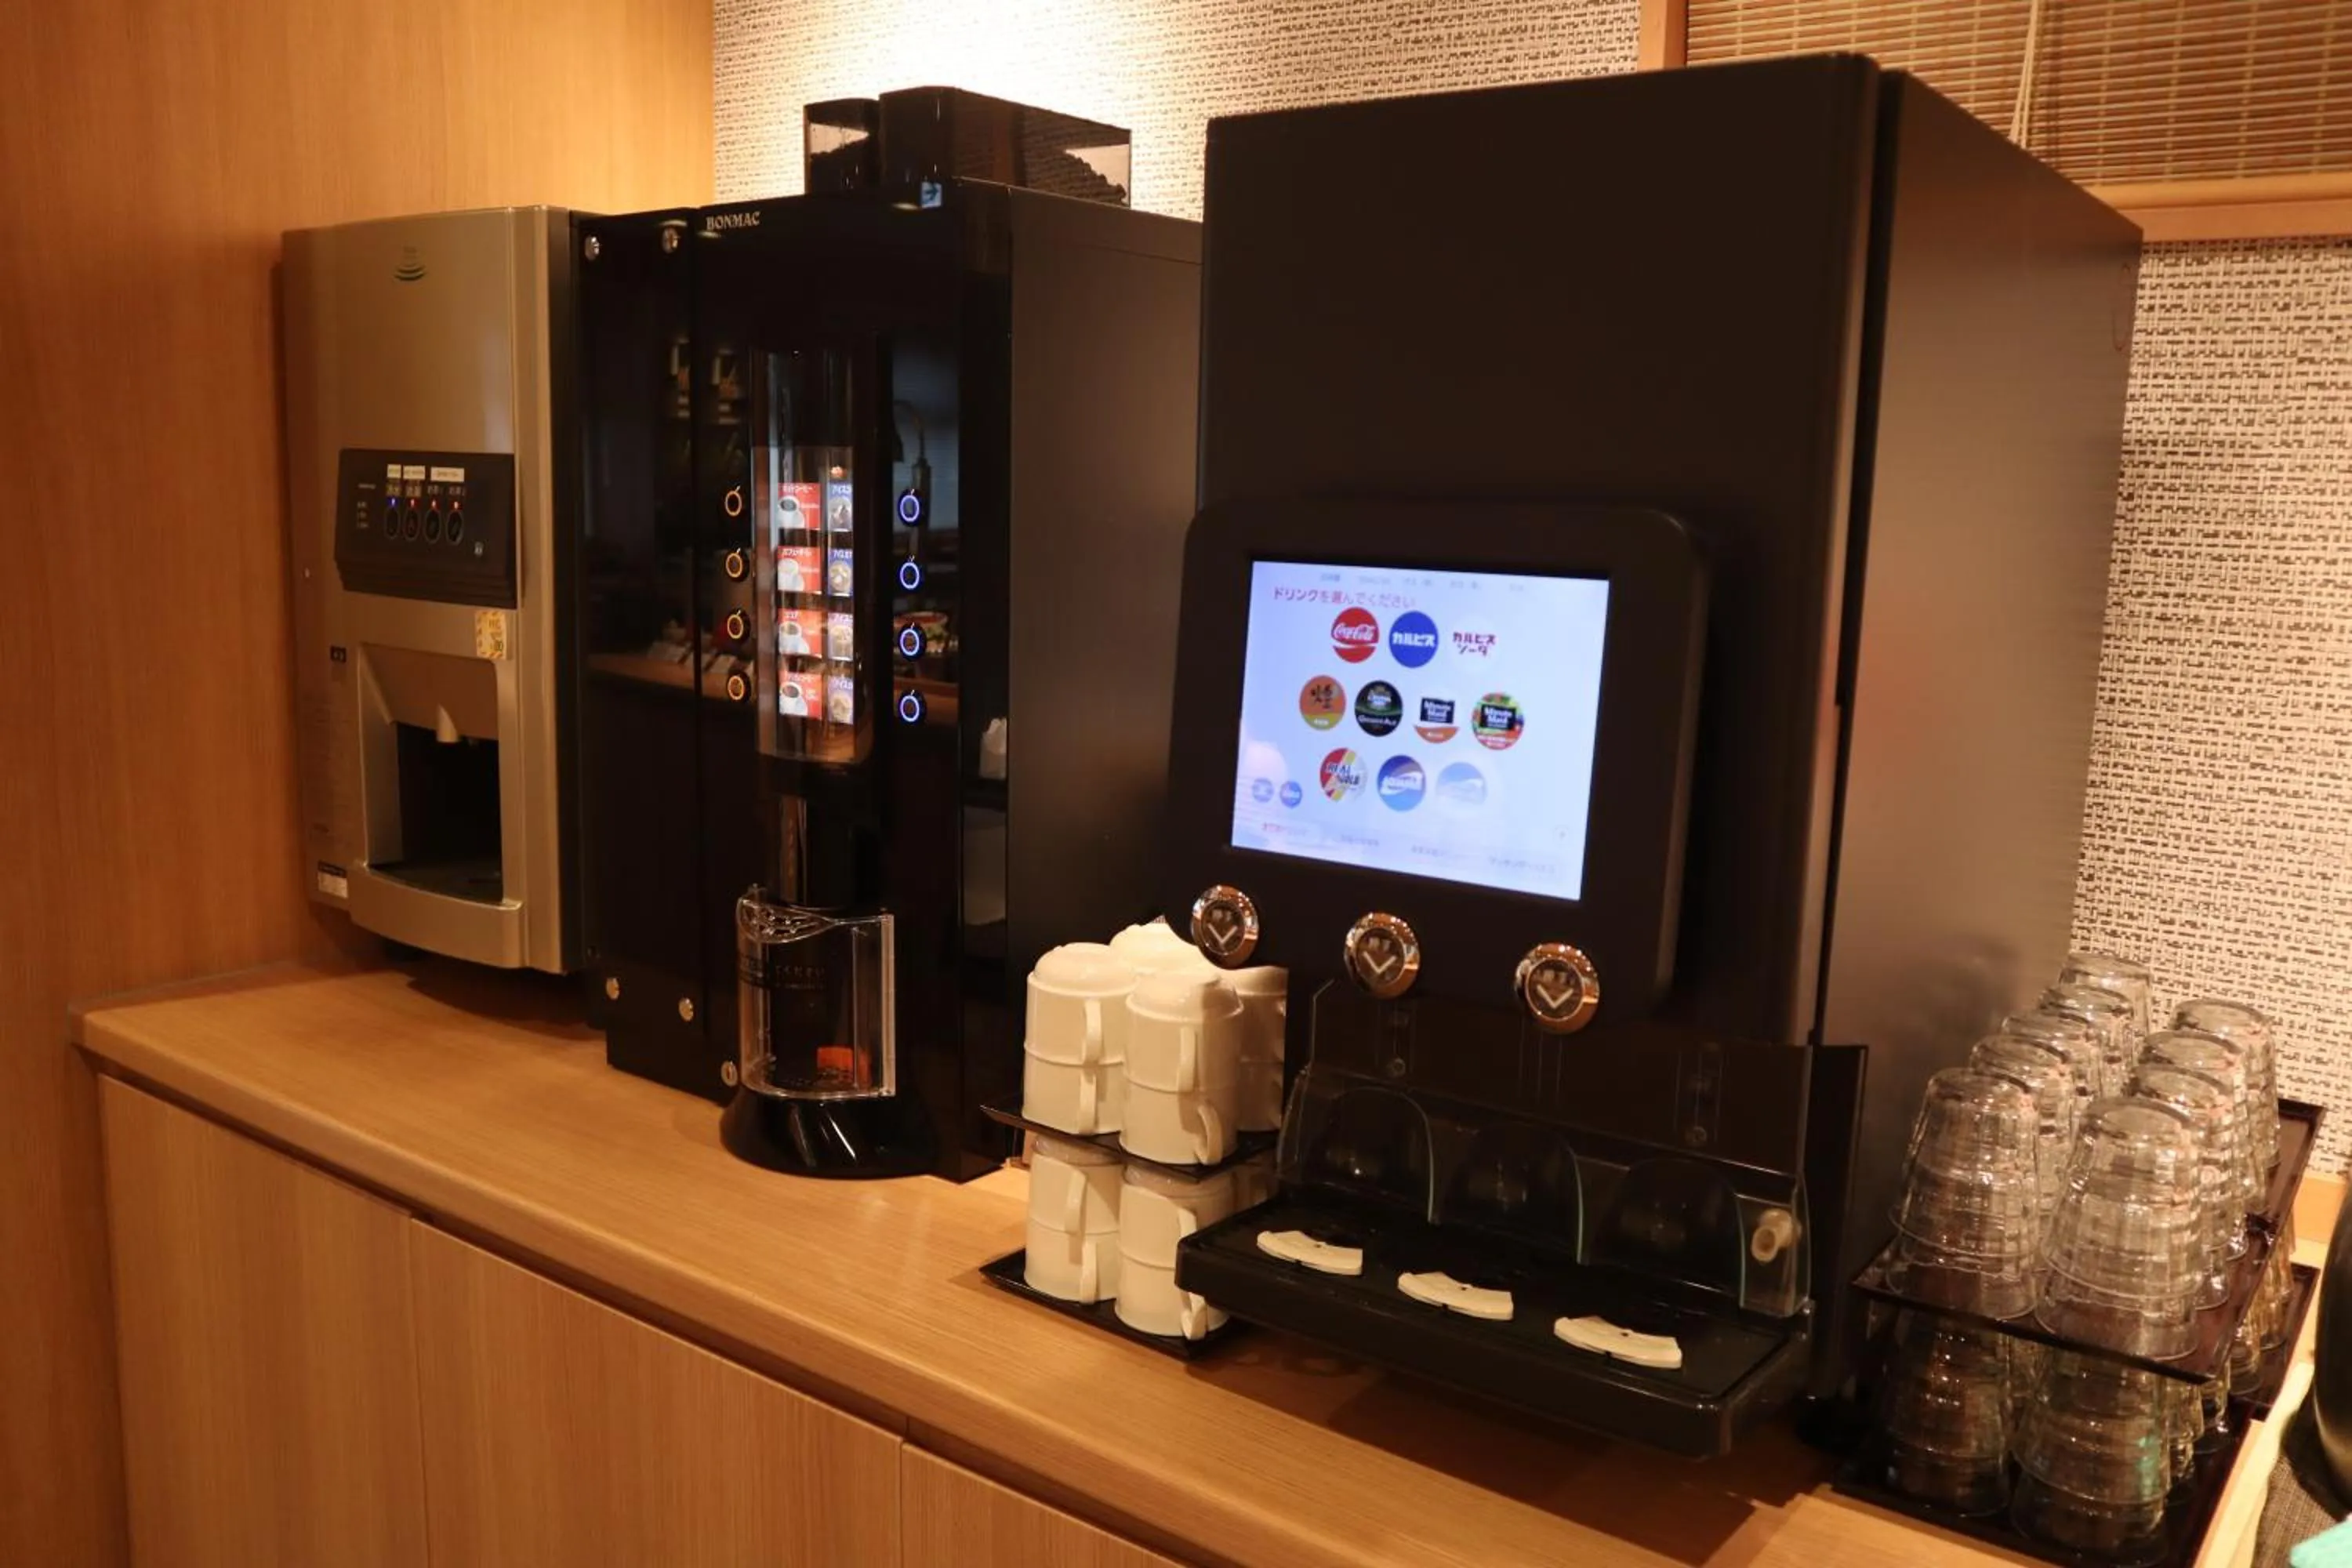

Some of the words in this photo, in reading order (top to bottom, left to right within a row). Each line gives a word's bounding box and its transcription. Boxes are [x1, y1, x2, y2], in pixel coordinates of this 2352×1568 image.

[706, 211, 760, 230] BONMAC
[1273, 586, 1415, 608] ドリンクを選んでください
[1392, 632, 1436, 648] カルピス
[1452, 631, 1496, 645] カルピス
